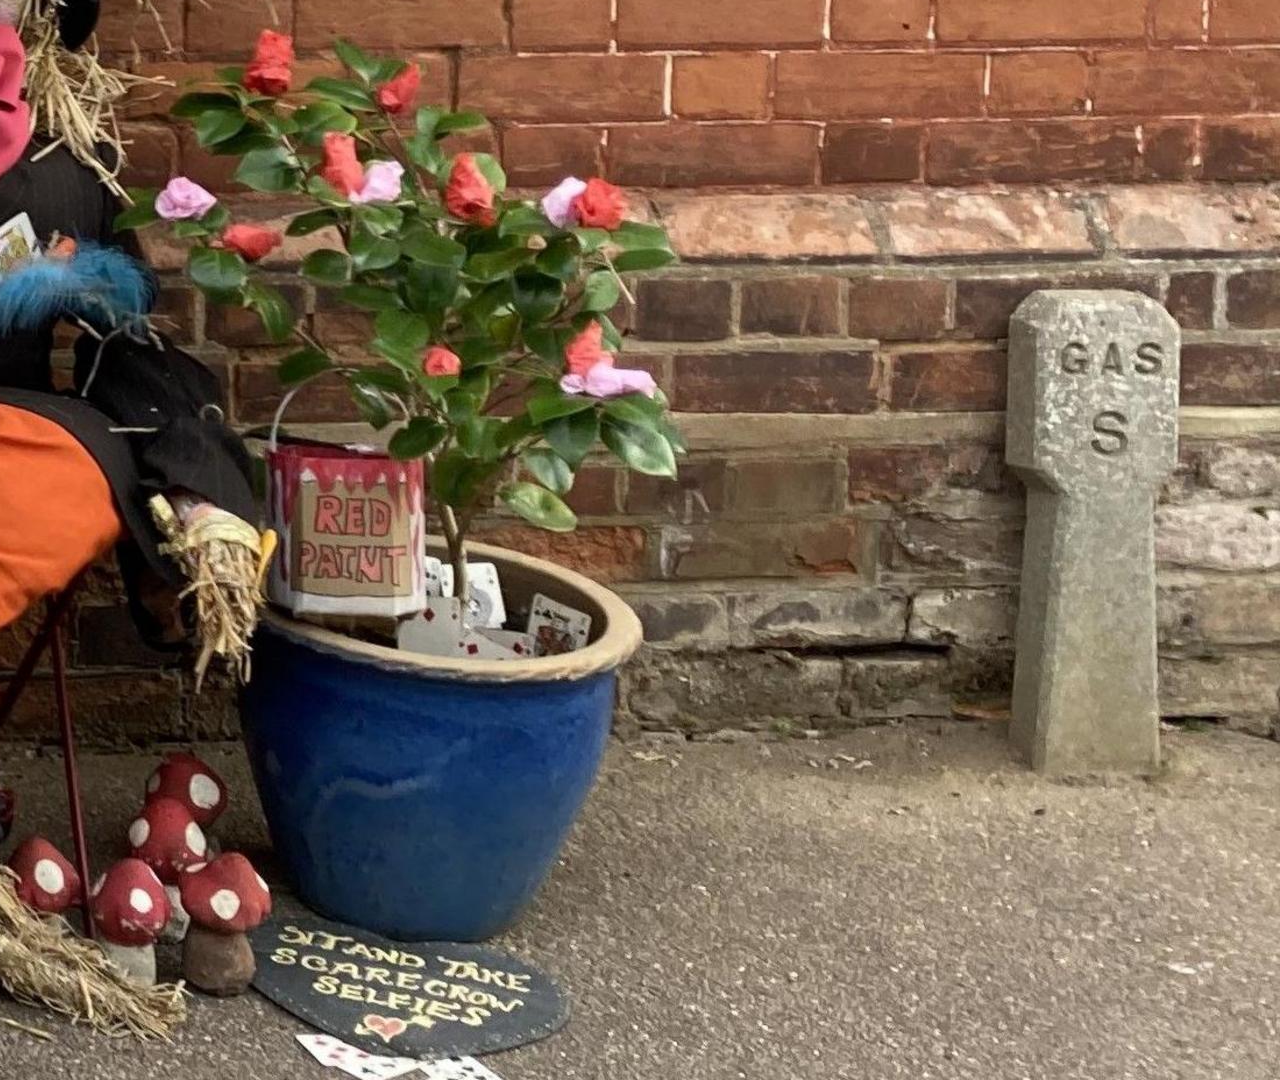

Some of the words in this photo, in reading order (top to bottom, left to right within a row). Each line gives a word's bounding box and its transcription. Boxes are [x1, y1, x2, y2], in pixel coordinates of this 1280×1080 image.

[1060, 341, 1165, 376] GAS
[1091, 410, 1129, 455] S
[314, 495, 393, 537] RED
[298, 540, 408, 588] PAINT
[342, 942, 427, 970] AND
[436, 955, 532, 993] TAKE
[312, 975, 491, 1026] SELFIES
